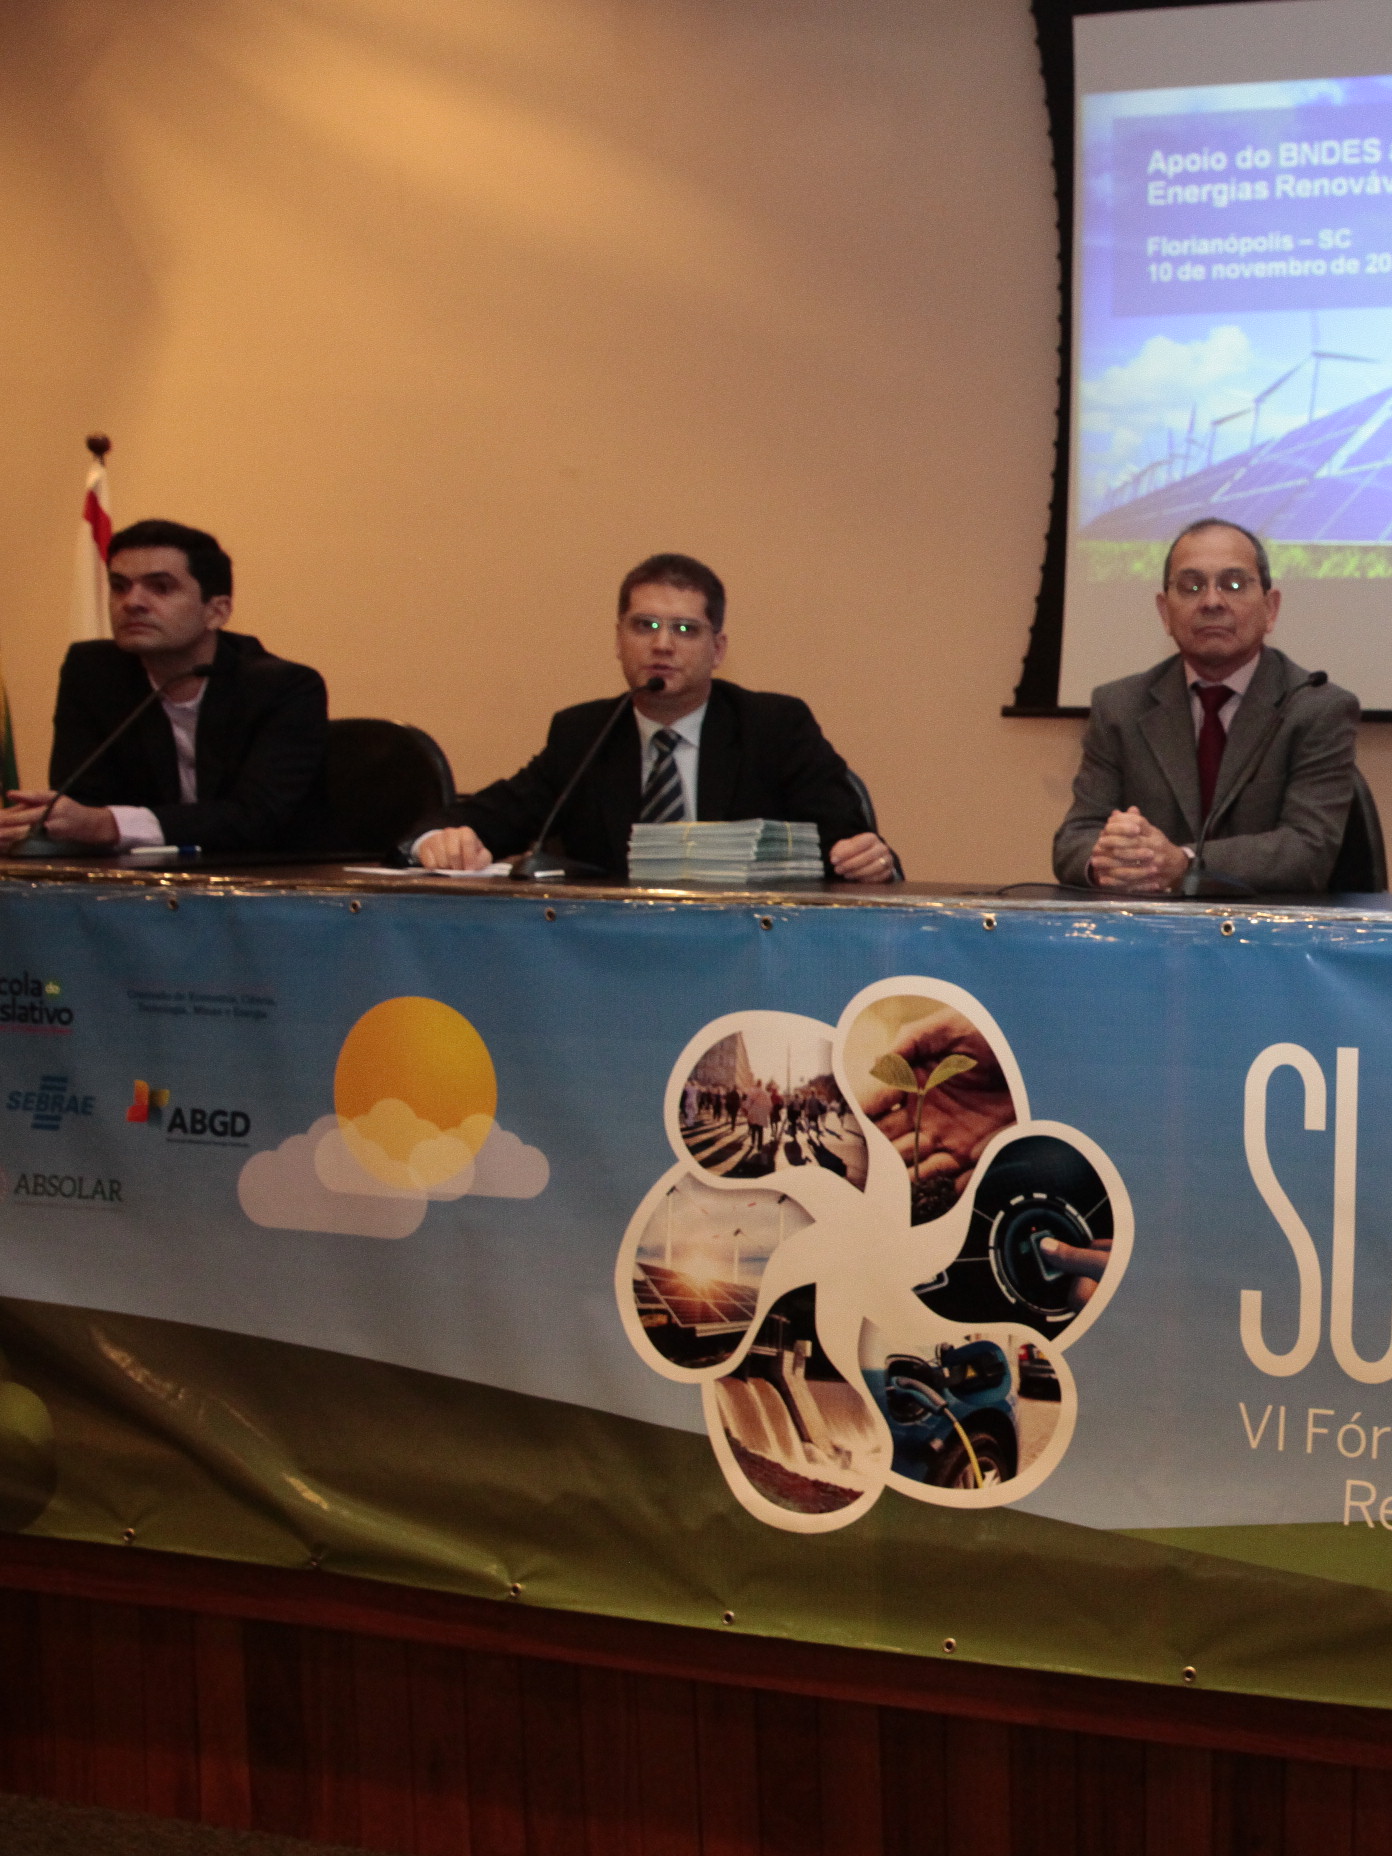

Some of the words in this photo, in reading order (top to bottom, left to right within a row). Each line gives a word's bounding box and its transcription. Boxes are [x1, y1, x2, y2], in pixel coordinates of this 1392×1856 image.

[1147, 149, 1227, 179] Apoio
[1234, 145, 1272, 171] do
[1278, 137, 1382, 168] BNDES
[1147, 176, 1270, 208] Energias
[1147, 233, 1295, 258] Florianópolis
[1317, 227, 1352, 250] SC
[1147, 262, 1173, 283] 10
[1175, 262, 1206, 282] de
[1211, 256, 1328, 281] novembro
[1330, 253, 1361, 276] de
[7, 1090, 96, 1117] SEBRAE
[167, 1107, 250, 1138] ABGD
[14, 1173, 122, 1201] ABSOLAR
[1239, 1402, 1287, 1452] VI
